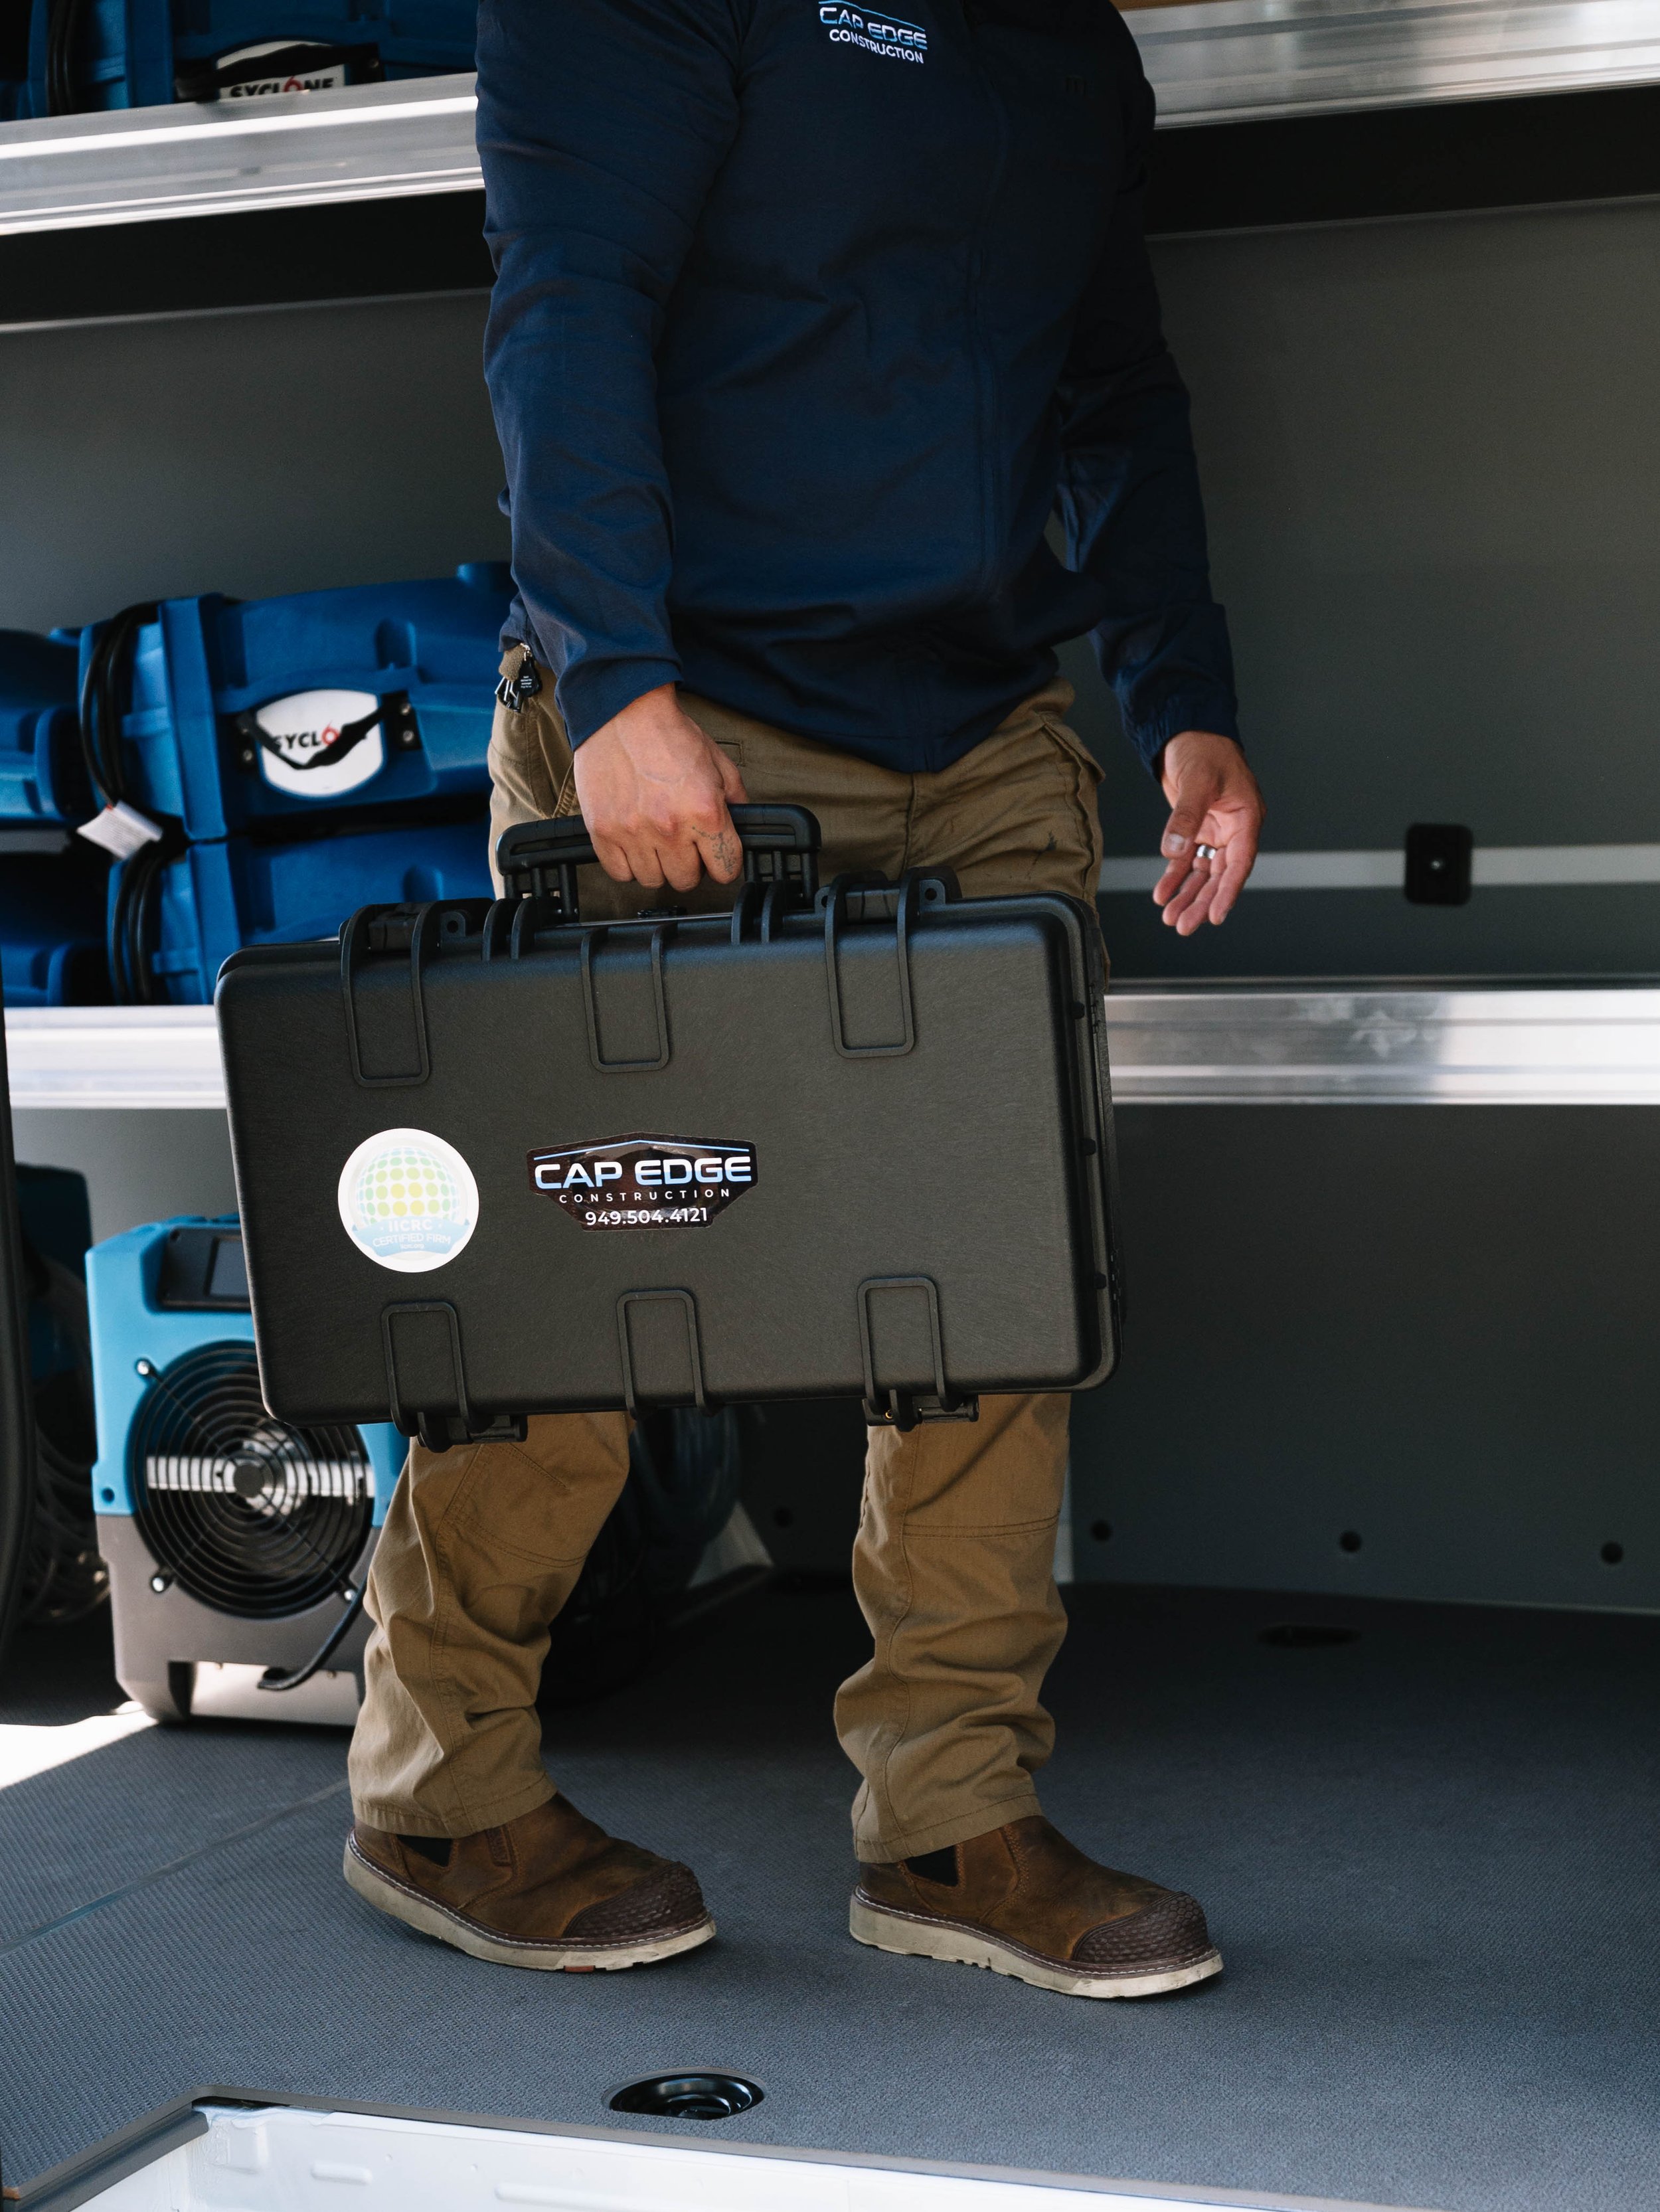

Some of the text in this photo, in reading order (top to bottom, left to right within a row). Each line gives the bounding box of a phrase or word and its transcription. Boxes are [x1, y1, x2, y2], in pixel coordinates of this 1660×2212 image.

[819, 7, 928, 50] CAP EDGE
[829, 29, 924, 64] CONSTRUCTION
[535, 1156, 752, 1189] CAP EDGE
[559, 1189, 730, 1203] CONSTRUCTION
[585, 1207, 708, 1225] 949.504.4121
[389, 1220, 433, 1233] IICRC
[373, 1234, 451, 1246] CERTIFIED FIRM
